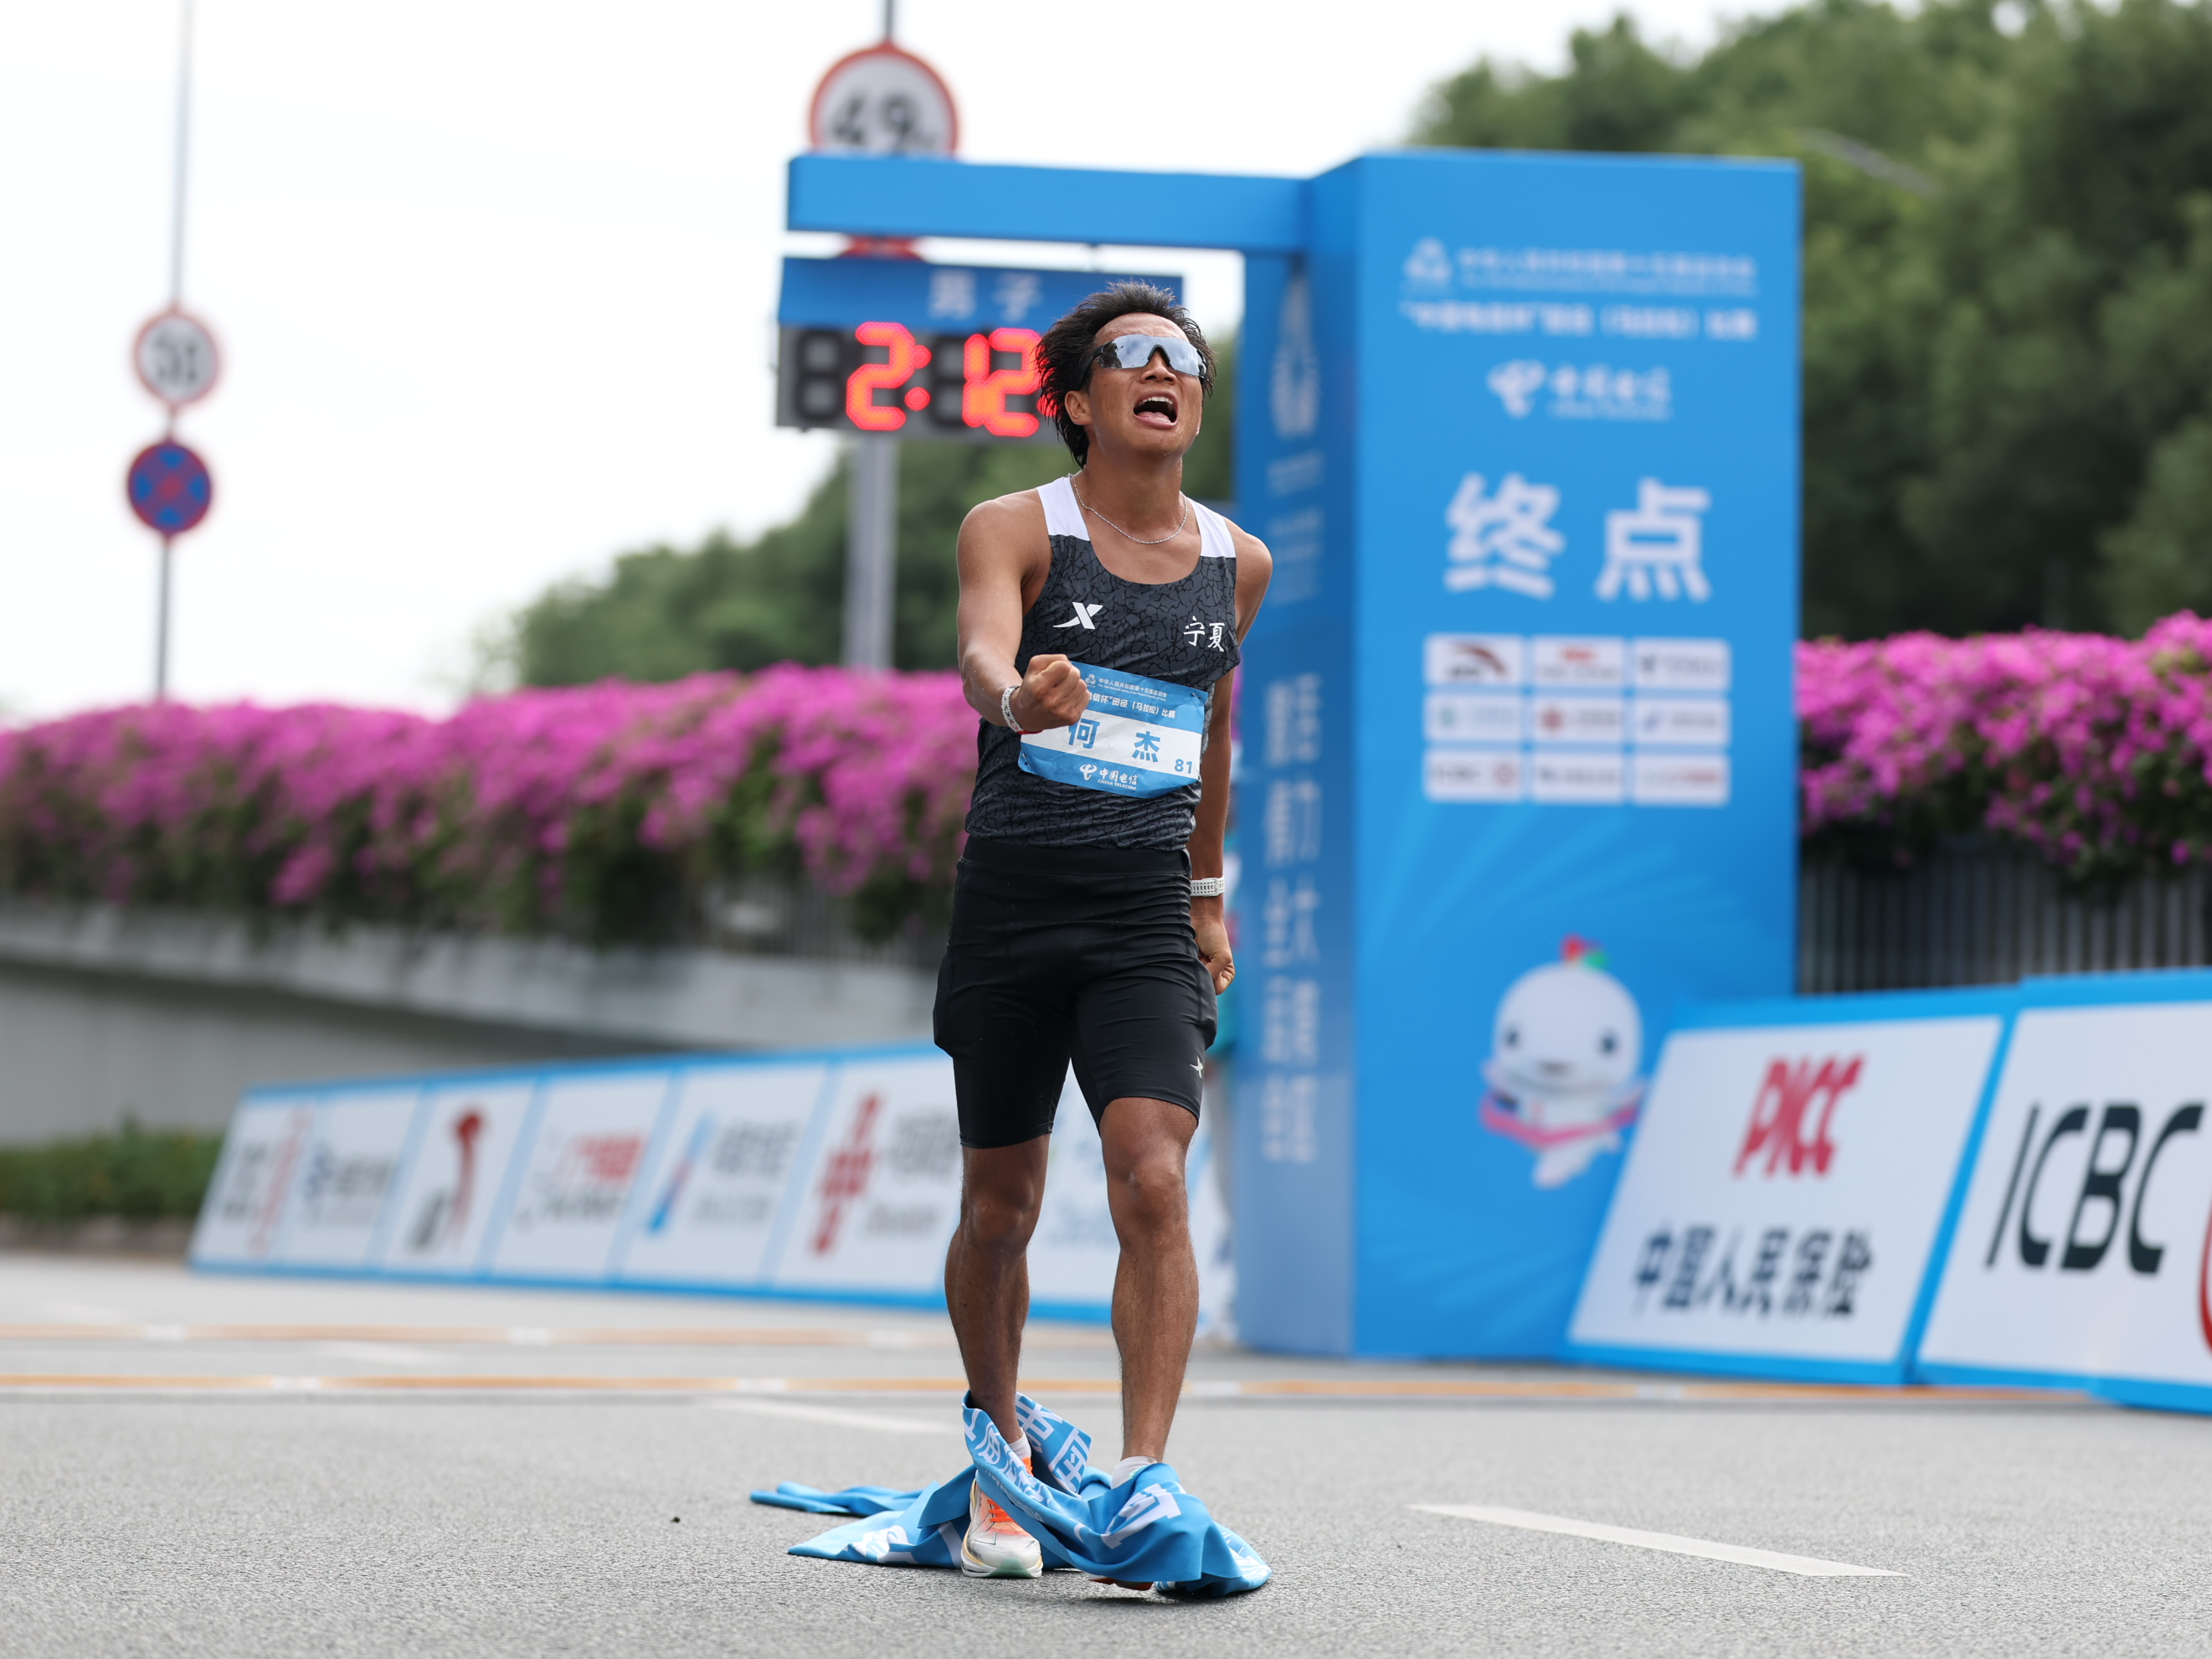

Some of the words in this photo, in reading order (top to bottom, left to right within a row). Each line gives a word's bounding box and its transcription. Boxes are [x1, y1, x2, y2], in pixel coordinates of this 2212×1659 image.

[1443, 471, 1712, 603] 终点
[1183, 616, 1226, 652] 宁夏
[1099, 768, 1139, 786] 中国电信
[1174, 759, 1193, 774] 81
[1114, 782, 1137, 791] TELECOM
[1732, 1054, 1865, 1178] PICC
[1984, 1100, 2207, 1275] ICBC
